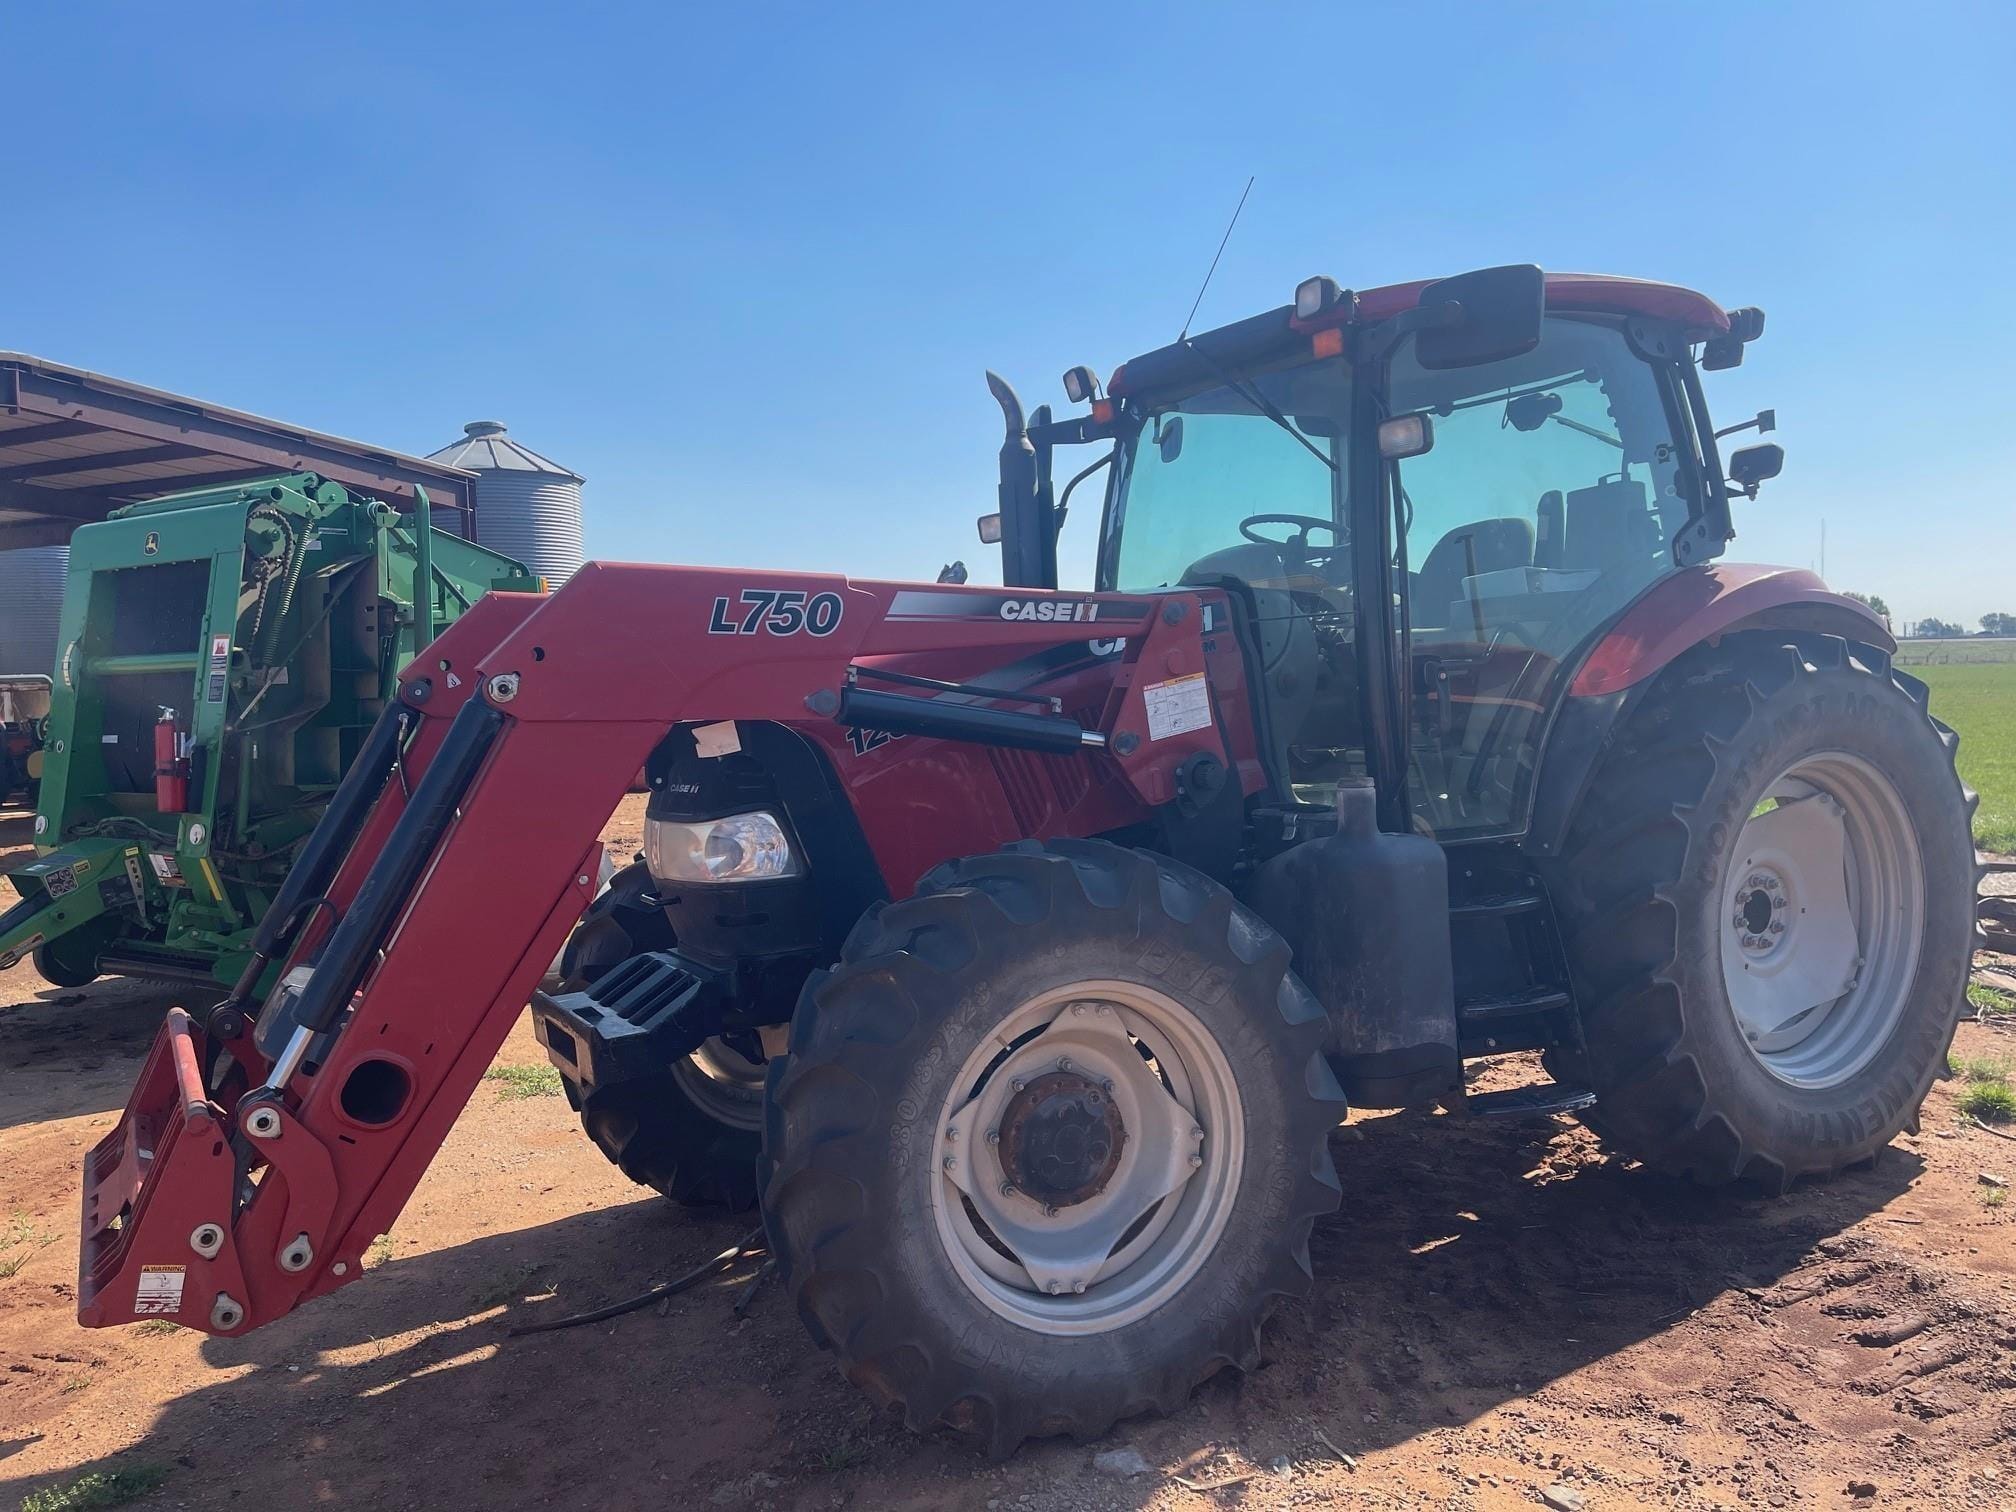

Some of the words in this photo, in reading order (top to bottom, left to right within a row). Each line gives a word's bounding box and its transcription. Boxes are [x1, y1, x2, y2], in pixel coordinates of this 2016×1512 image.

[708, 589, 844, 637] L750
[1000, 600, 1073, 622] CASE
[670, 784, 690, 792] CASE
